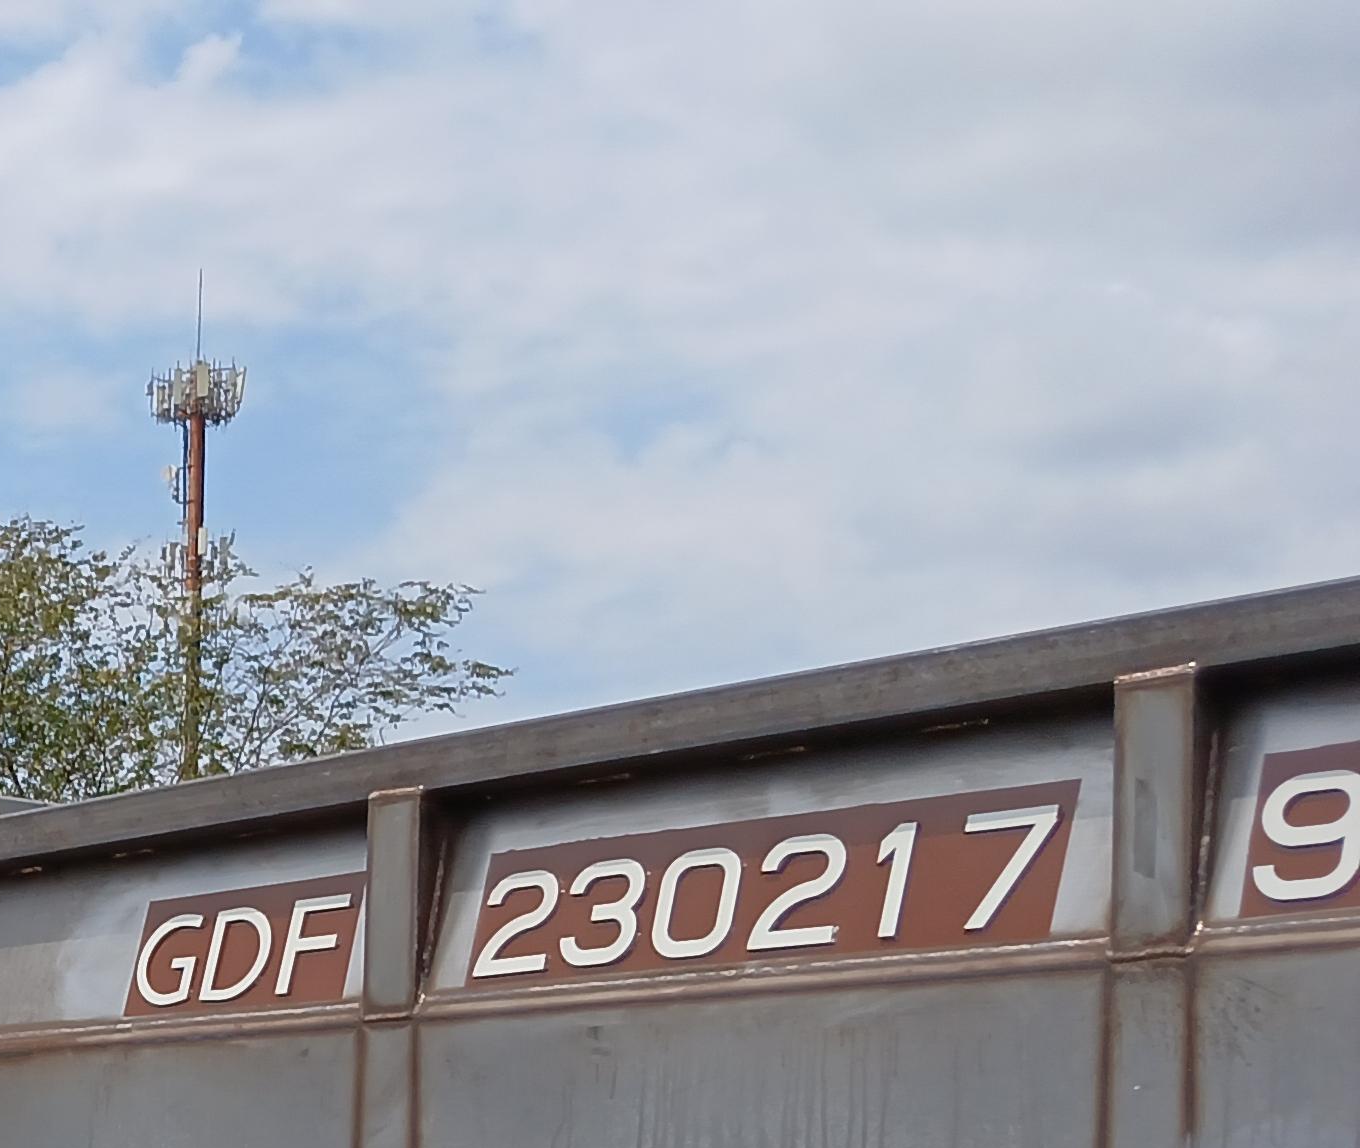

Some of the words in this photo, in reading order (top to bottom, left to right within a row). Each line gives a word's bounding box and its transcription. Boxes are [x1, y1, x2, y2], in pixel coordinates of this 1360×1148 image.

[137, 893, 352, 1006] GDF
[473, 804, 1060, 978] 230217
[1252, 769, 1360, 901] 9
